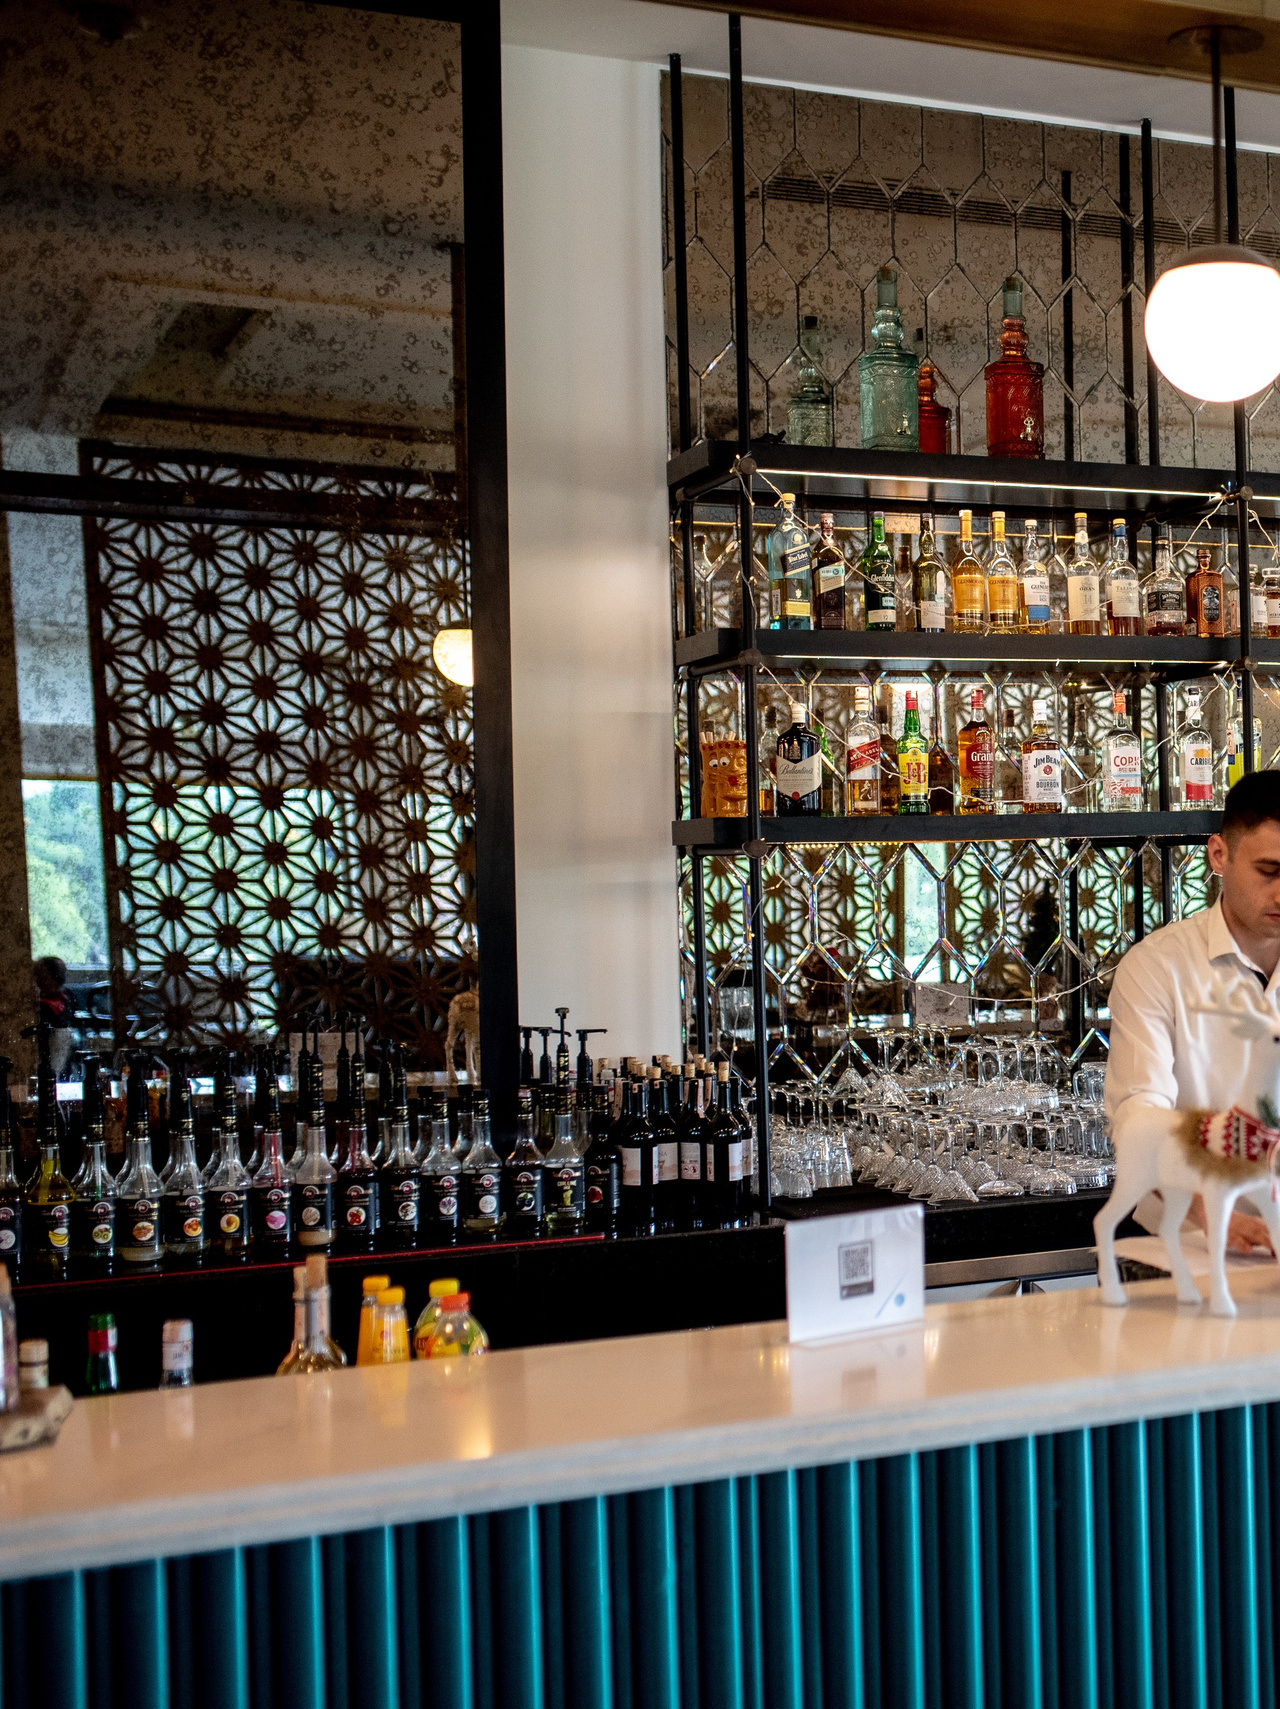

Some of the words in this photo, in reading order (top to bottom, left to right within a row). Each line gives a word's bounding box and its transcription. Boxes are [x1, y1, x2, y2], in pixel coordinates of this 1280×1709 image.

[1034, 757, 1046, 769] JIM
[903, 762, 927, 785] J&B
[1036, 781, 1060, 789] BOURBON
